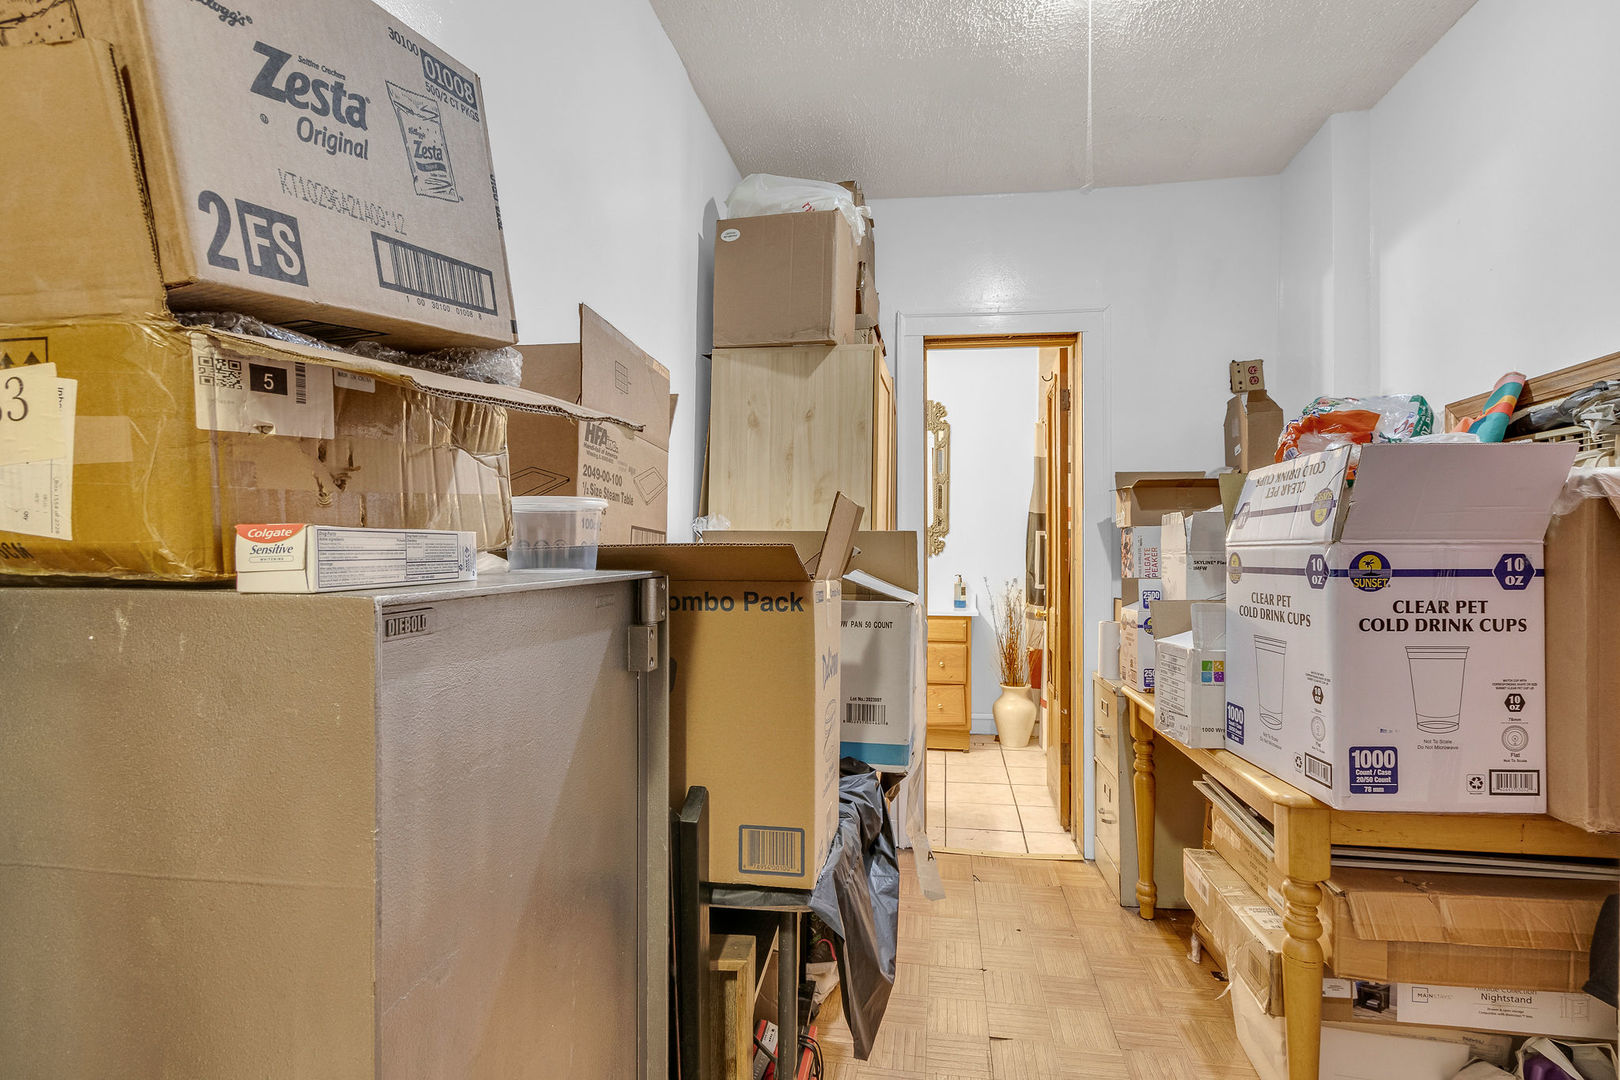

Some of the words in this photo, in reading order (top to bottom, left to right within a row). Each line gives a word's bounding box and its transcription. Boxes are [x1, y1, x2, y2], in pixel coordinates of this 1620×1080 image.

[388, 27, 419, 56] 30100
[424, 54, 475, 107] 01008
[250, 40, 368, 130] Zesta
[296, 116, 369, 160] Original
[413, 139, 444, 161] Zesta
[263, 373, 275, 390] 5
[0, 376, 29, 422] 3
[585, 421, 608, 447] HFA
[583, 463, 623, 487] 2049-00-100
[589, 482, 603, 498] Size
[603, 486, 621, 503] Steam
[620, 491, 634, 506] Table
[247, 528, 293, 541] Colgate
[249, 543, 294, 556] Sensitive
[1143, 547, 1151, 579] AILGATE
[1151, 546, 1159, 578] PEAKER
[1311, 557, 1323, 572] 10
[1504, 556, 1525, 572] 10
[1311, 575, 1323, 585] OZ
[1353, 577, 1388, 589] SUNSET
[1504, 575, 1524, 587] OZ
[669, 592, 735, 612] ombo
[743, 592, 805, 612] Pack
[1143, 591, 1160, 599] 2500
[1251, 591, 1275, 606] CLEAR
[1276, 594, 1292, 608] PET
[1392, 599, 1450, 614] CLEAR
[1455, 600, 1488, 614] PET
[864, 621, 872, 629] 50
[873, 621, 893, 629] COUNT
[1239, 604, 1258, 619] COLD
[1260, 607, 1286, 623] DRINK
[1287, 611, 1311, 628] CUPS
[1358, 618, 1409, 632] COLD
[1415, 618, 1474, 632] DRINK
[1479, 618, 1528, 632] CUPS
[386, 614, 428, 637] DIEBOLD
[1508, 695, 1521, 704] 10
[1227, 704, 1244, 725] 1000
[1352, 749, 1396, 769] 1000
[1480, 993, 1533, 1004] Nightstand
